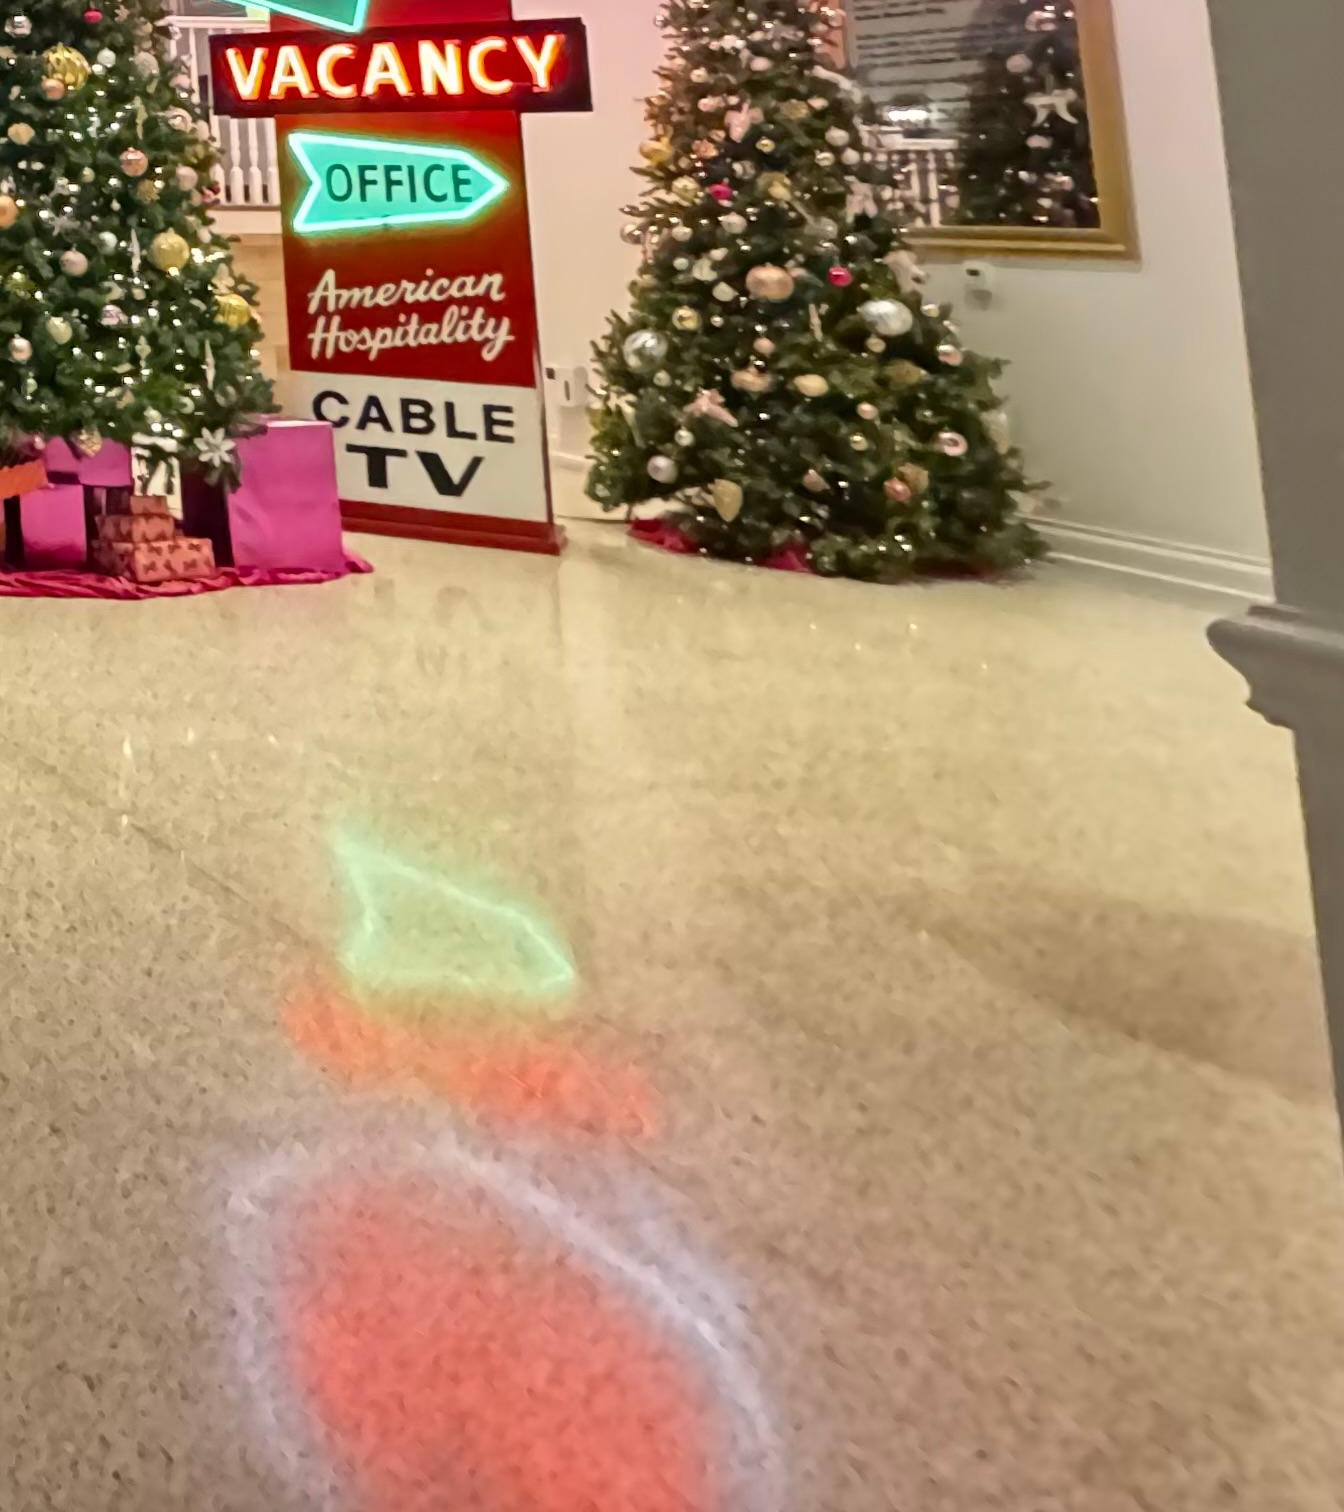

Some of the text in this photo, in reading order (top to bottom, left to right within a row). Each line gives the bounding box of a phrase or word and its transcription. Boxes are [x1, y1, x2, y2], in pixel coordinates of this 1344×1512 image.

[225, 33, 566, 101] VACANCY
[325, 163, 473, 203] OFFICE
[308, 268, 505, 314] American
[308, 304, 515, 361] Hospitality
[312, 390, 515, 444] CABLE
[345, 443, 484, 497] TV
